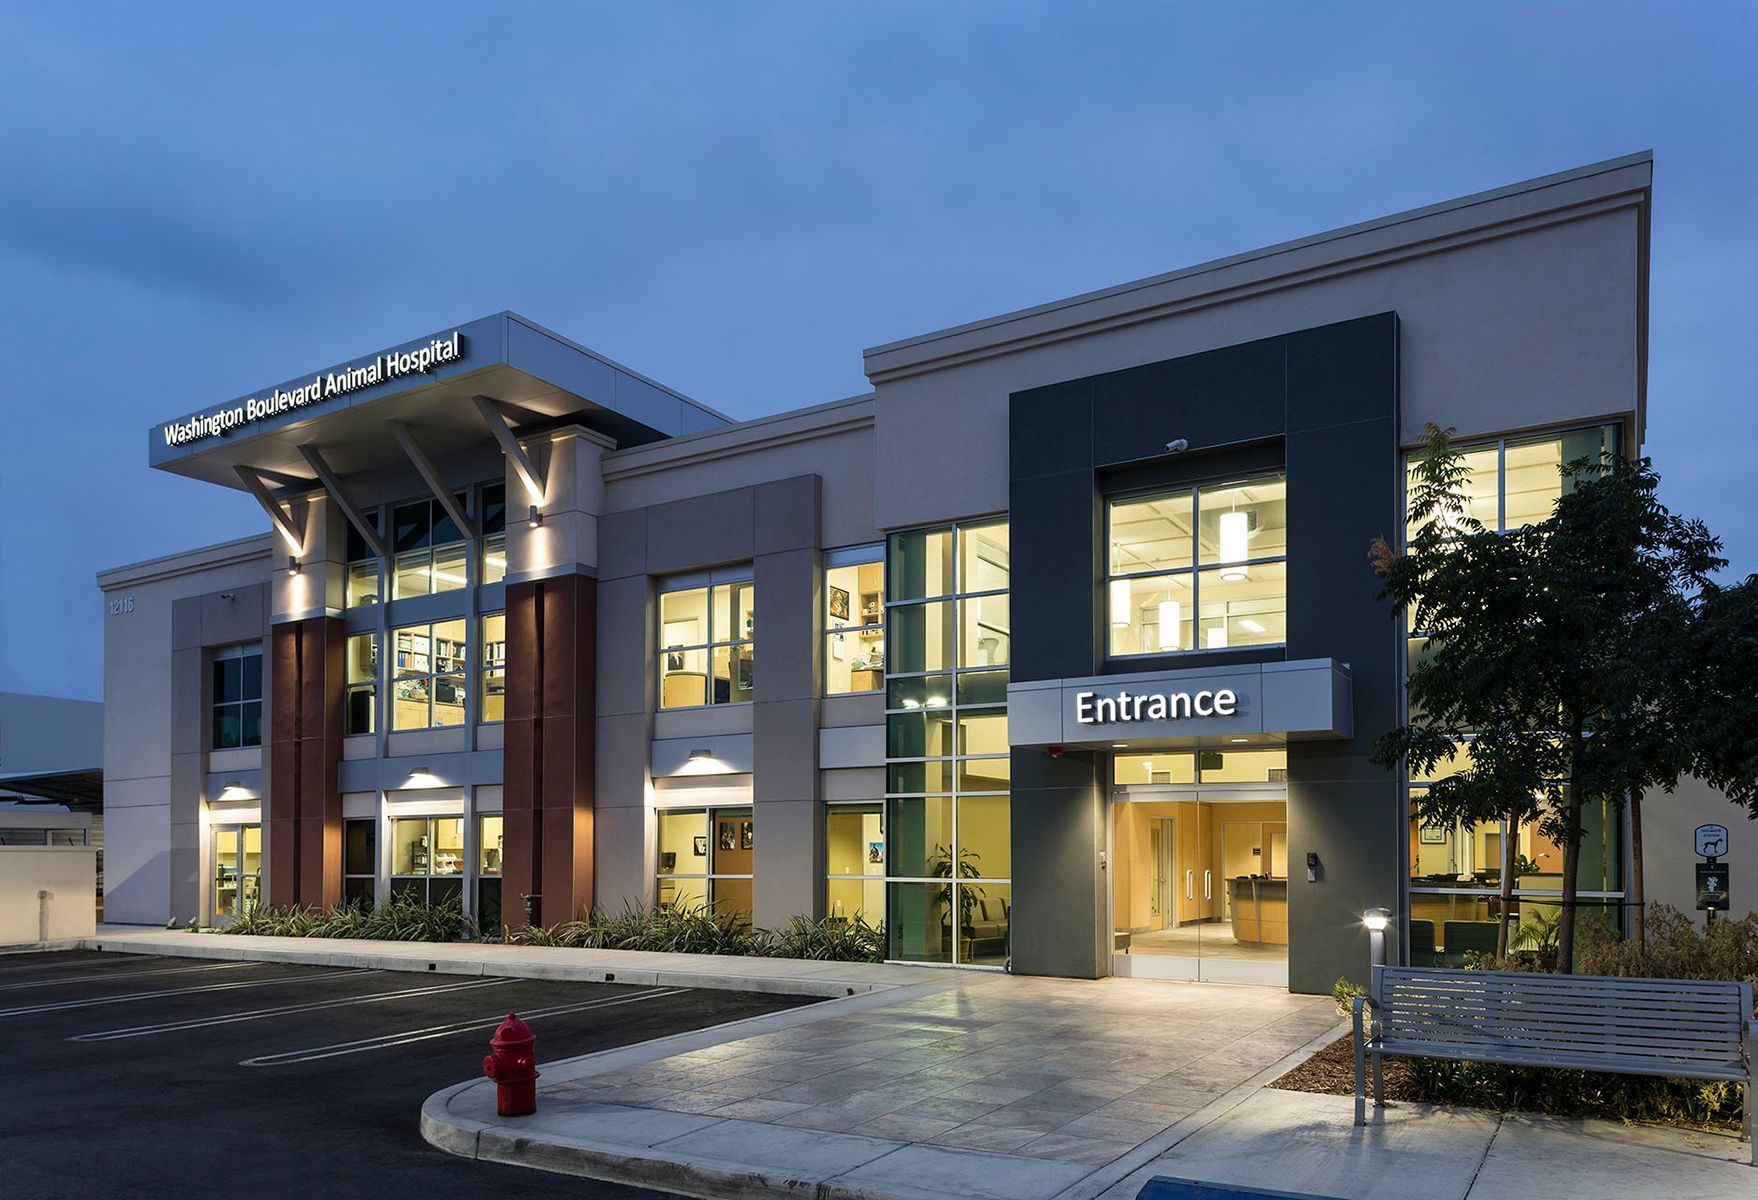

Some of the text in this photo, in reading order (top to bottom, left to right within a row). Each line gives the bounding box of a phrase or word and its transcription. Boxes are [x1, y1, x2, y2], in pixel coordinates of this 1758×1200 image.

[164, 331, 459, 445] Washington Boulevard Animal Hospital
[109, 596, 134, 614] 12116
[1076, 689, 1236, 723] Entrance
